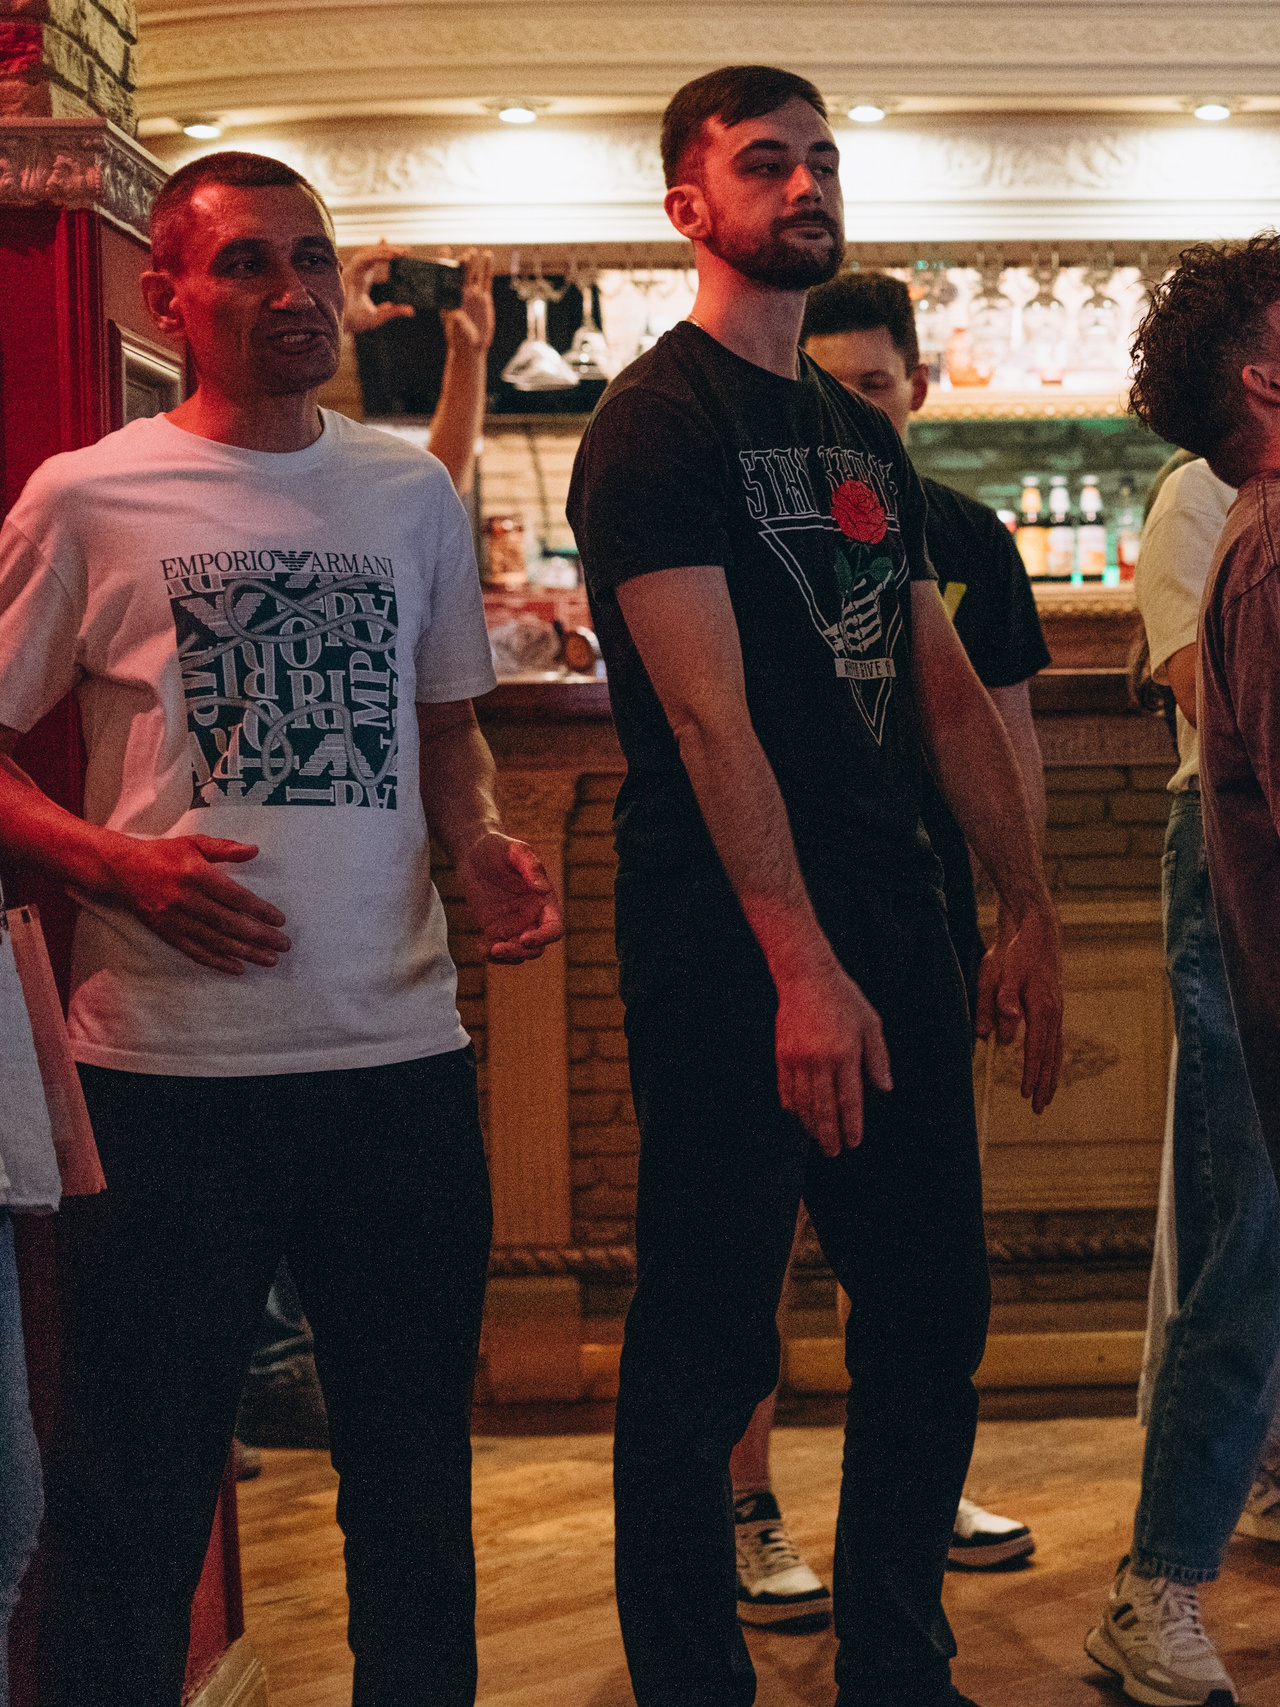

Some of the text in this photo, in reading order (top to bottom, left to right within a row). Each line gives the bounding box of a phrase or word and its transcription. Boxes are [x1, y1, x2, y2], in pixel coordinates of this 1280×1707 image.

[738, 447, 820, 520] STAY
[160, 550, 395, 581] EMPORIO ARMANI
